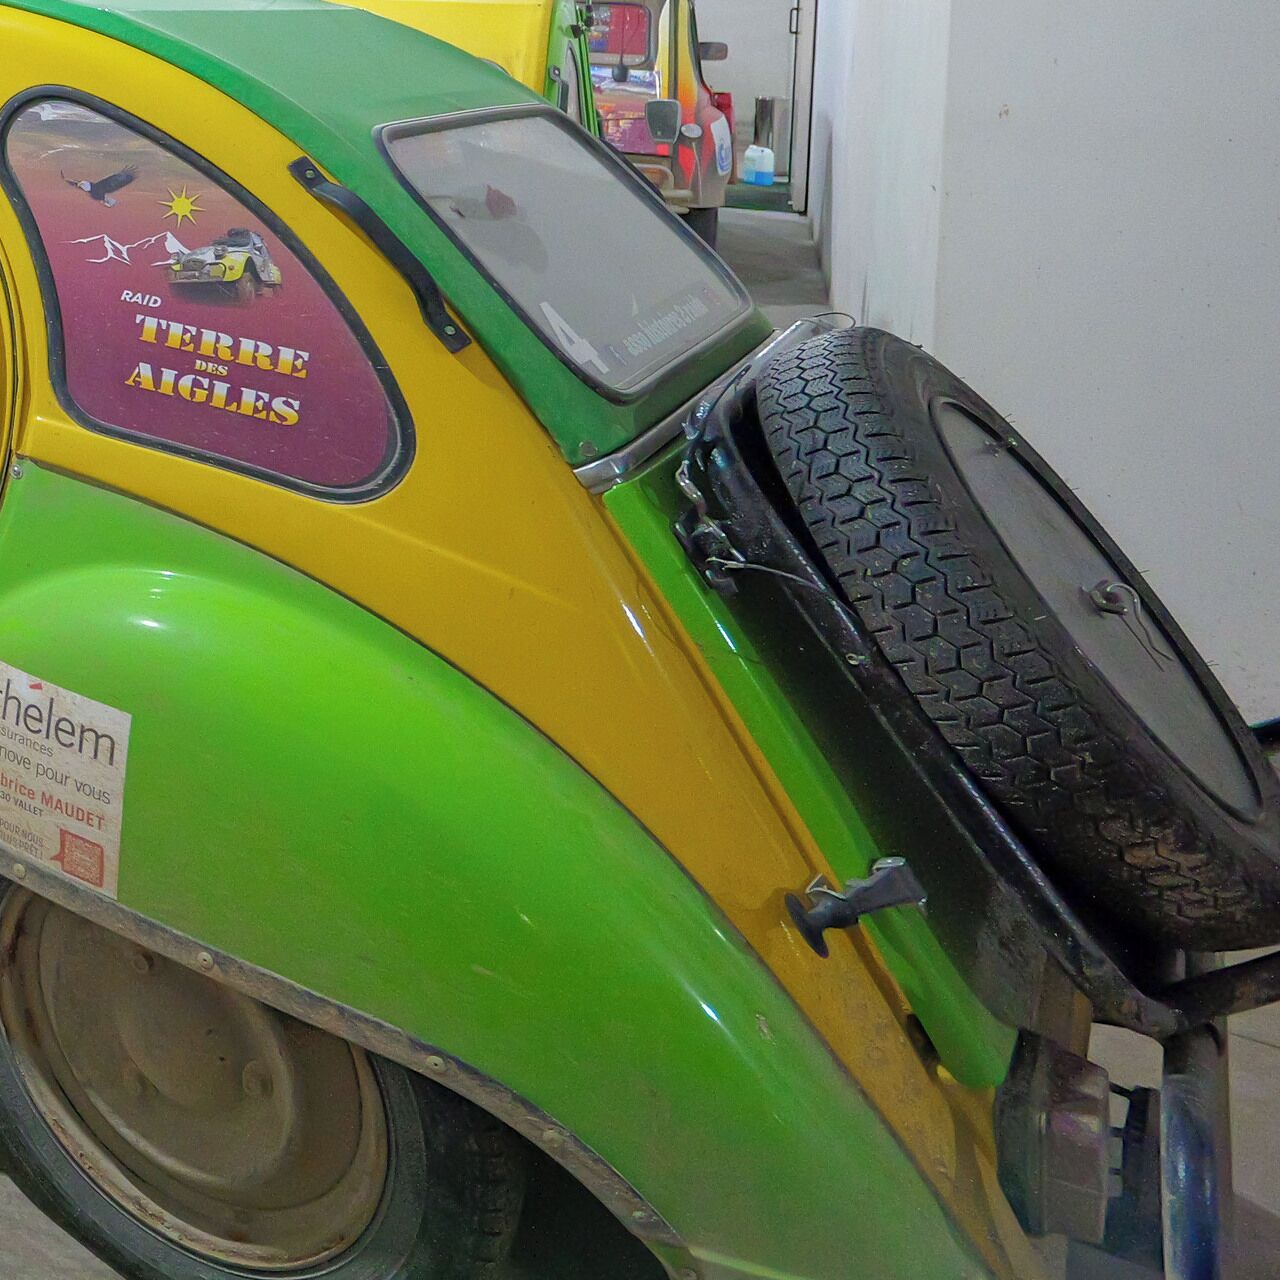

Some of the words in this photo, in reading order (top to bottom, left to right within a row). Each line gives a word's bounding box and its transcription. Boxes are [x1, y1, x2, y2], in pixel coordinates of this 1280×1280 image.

[120, 289, 163, 308] RAID
[135, 313, 310, 380] TERRE
[194, 358, 229, 377] DES
[124, 360, 301, 426] AIGLES
[35, 761, 71, 786] pour
[75, 780, 112, 806] vous
[13, 796, 44, 818] VALLET
[41, 790, 106, 832] MAUDET
